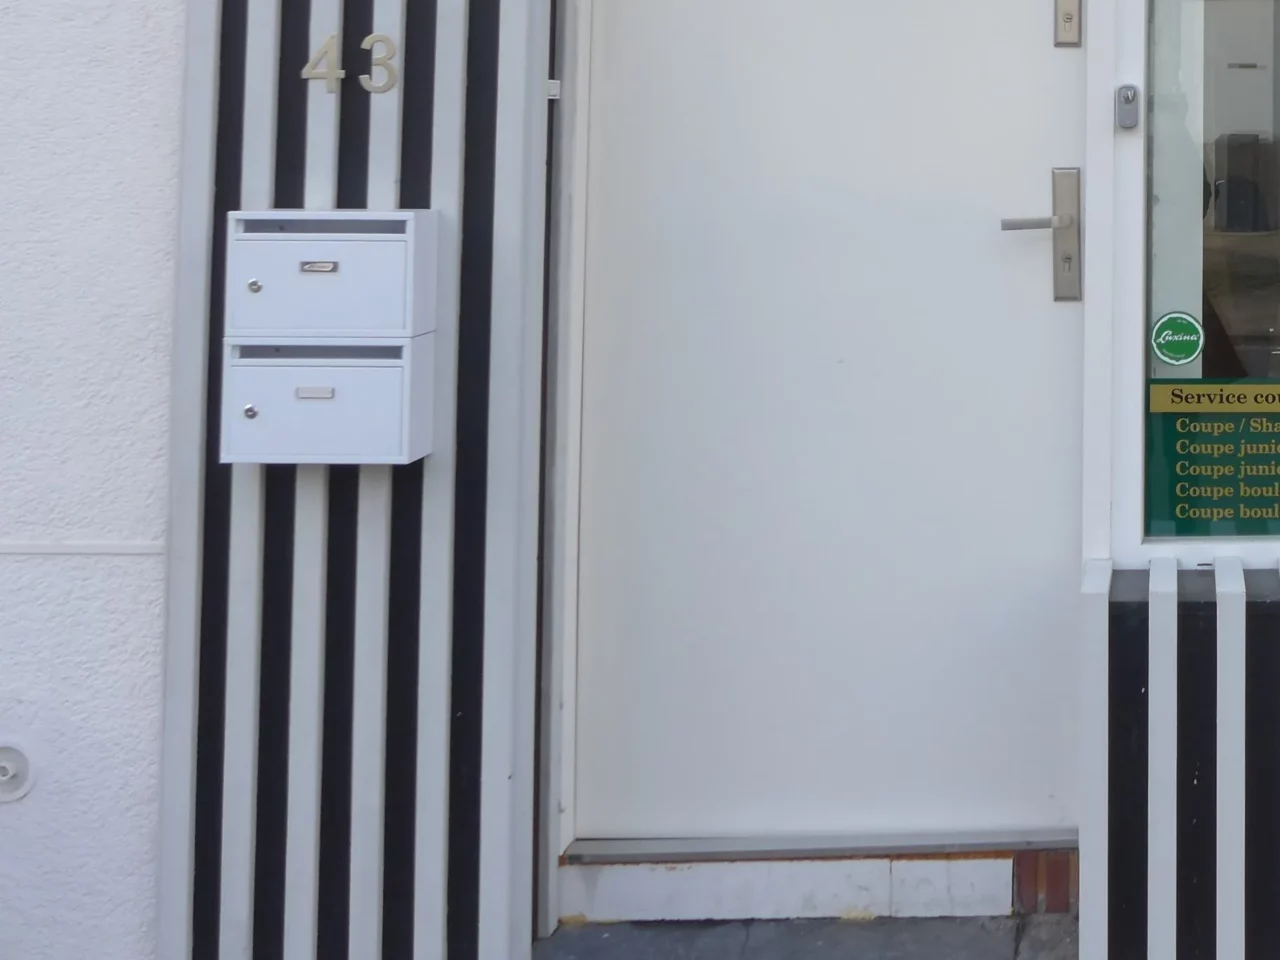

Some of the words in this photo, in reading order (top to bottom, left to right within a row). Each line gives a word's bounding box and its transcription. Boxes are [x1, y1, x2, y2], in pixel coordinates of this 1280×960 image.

[301, 33, 398, 94] 43
[1156, 330, 1199, 344] Luxina
[1170, 388, 1248, 404] Service
[1175, 418, 1235, 435] Coupe
[1239, 418, 1246, 433] /
[1175, 440, 1235, 457] Coupe
[1175, 461, 1235, 478] Coupe
[1175, 482, 1235, 500] Coupe
[1175, 504, 1235, 522] Coupe
